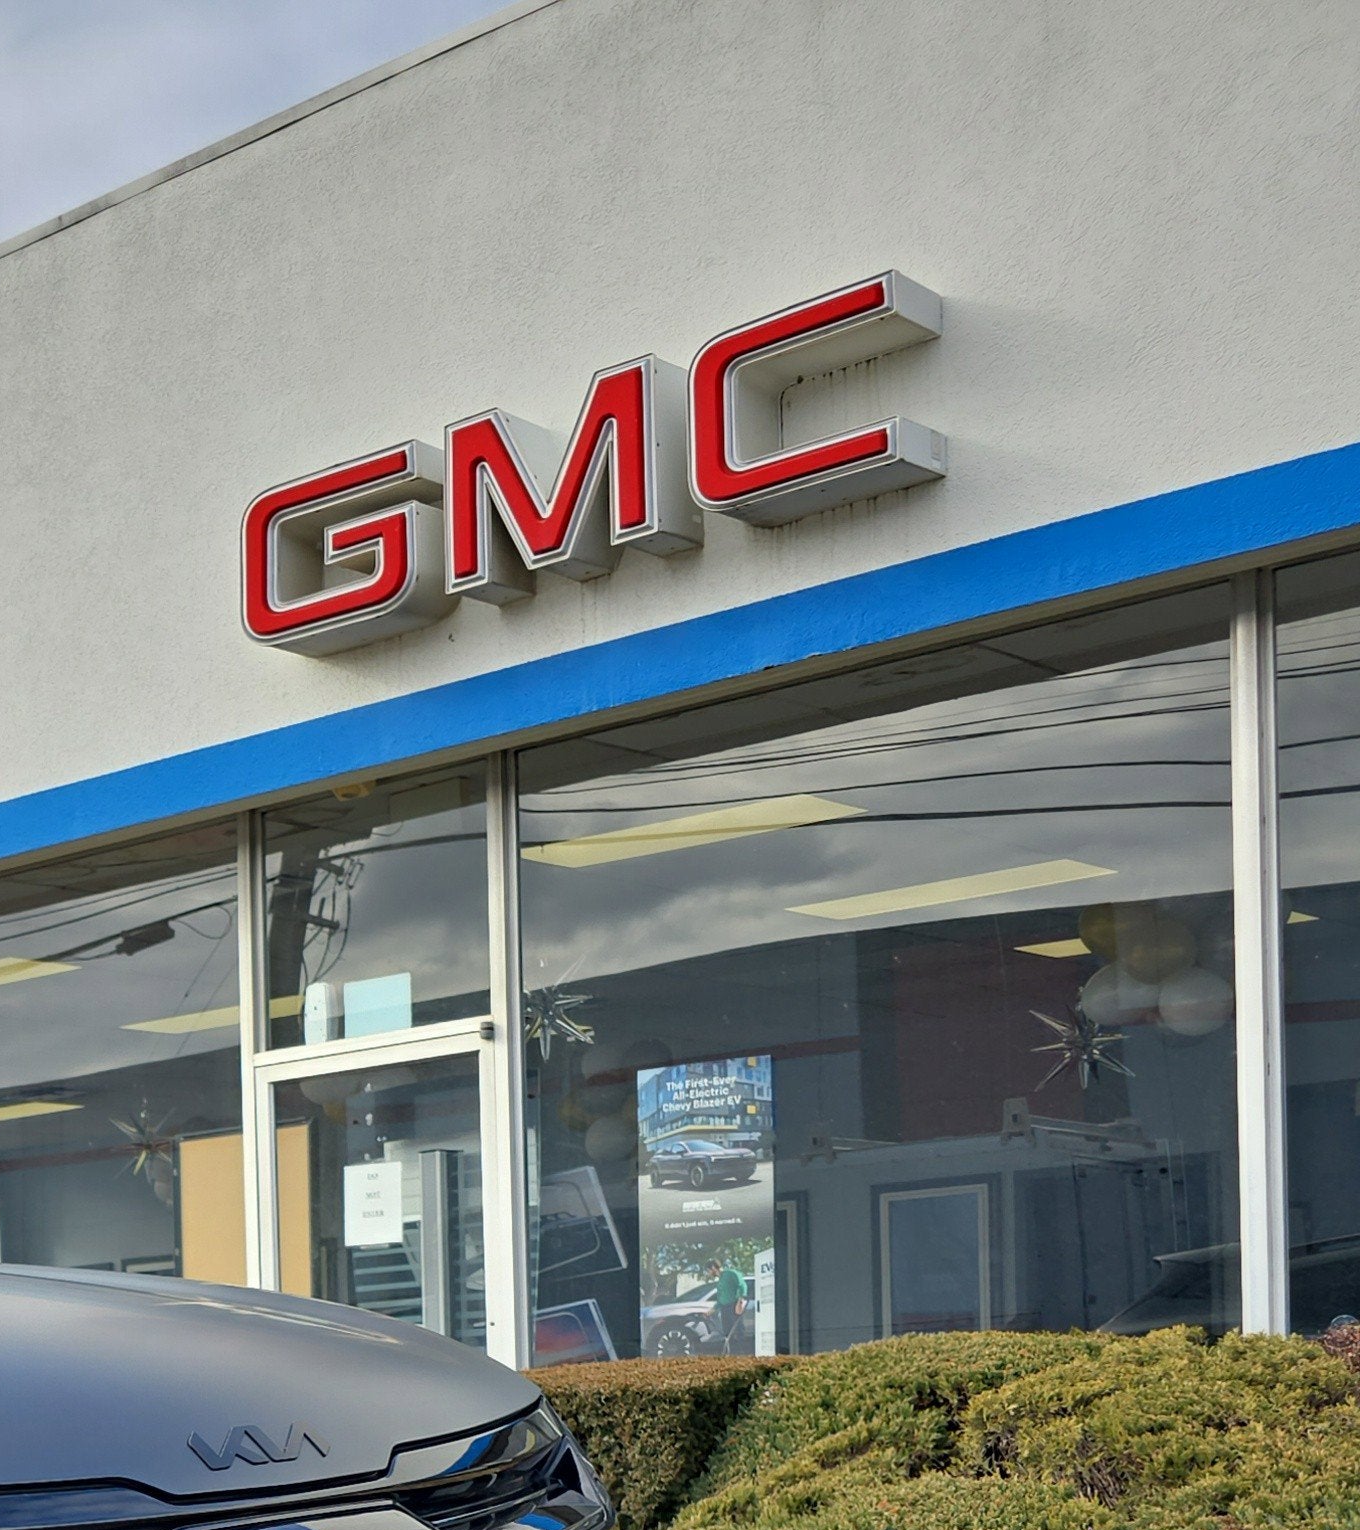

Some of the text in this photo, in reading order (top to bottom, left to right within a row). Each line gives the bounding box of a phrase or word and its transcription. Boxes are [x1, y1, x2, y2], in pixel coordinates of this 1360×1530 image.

[241, 269, 915, 648] GMC
[666, 1081, 683, 1091] The
[673, 1087, 729, 1101] All-Electric
[663, 1095, 741, 1112] Chevy Blazer EV
